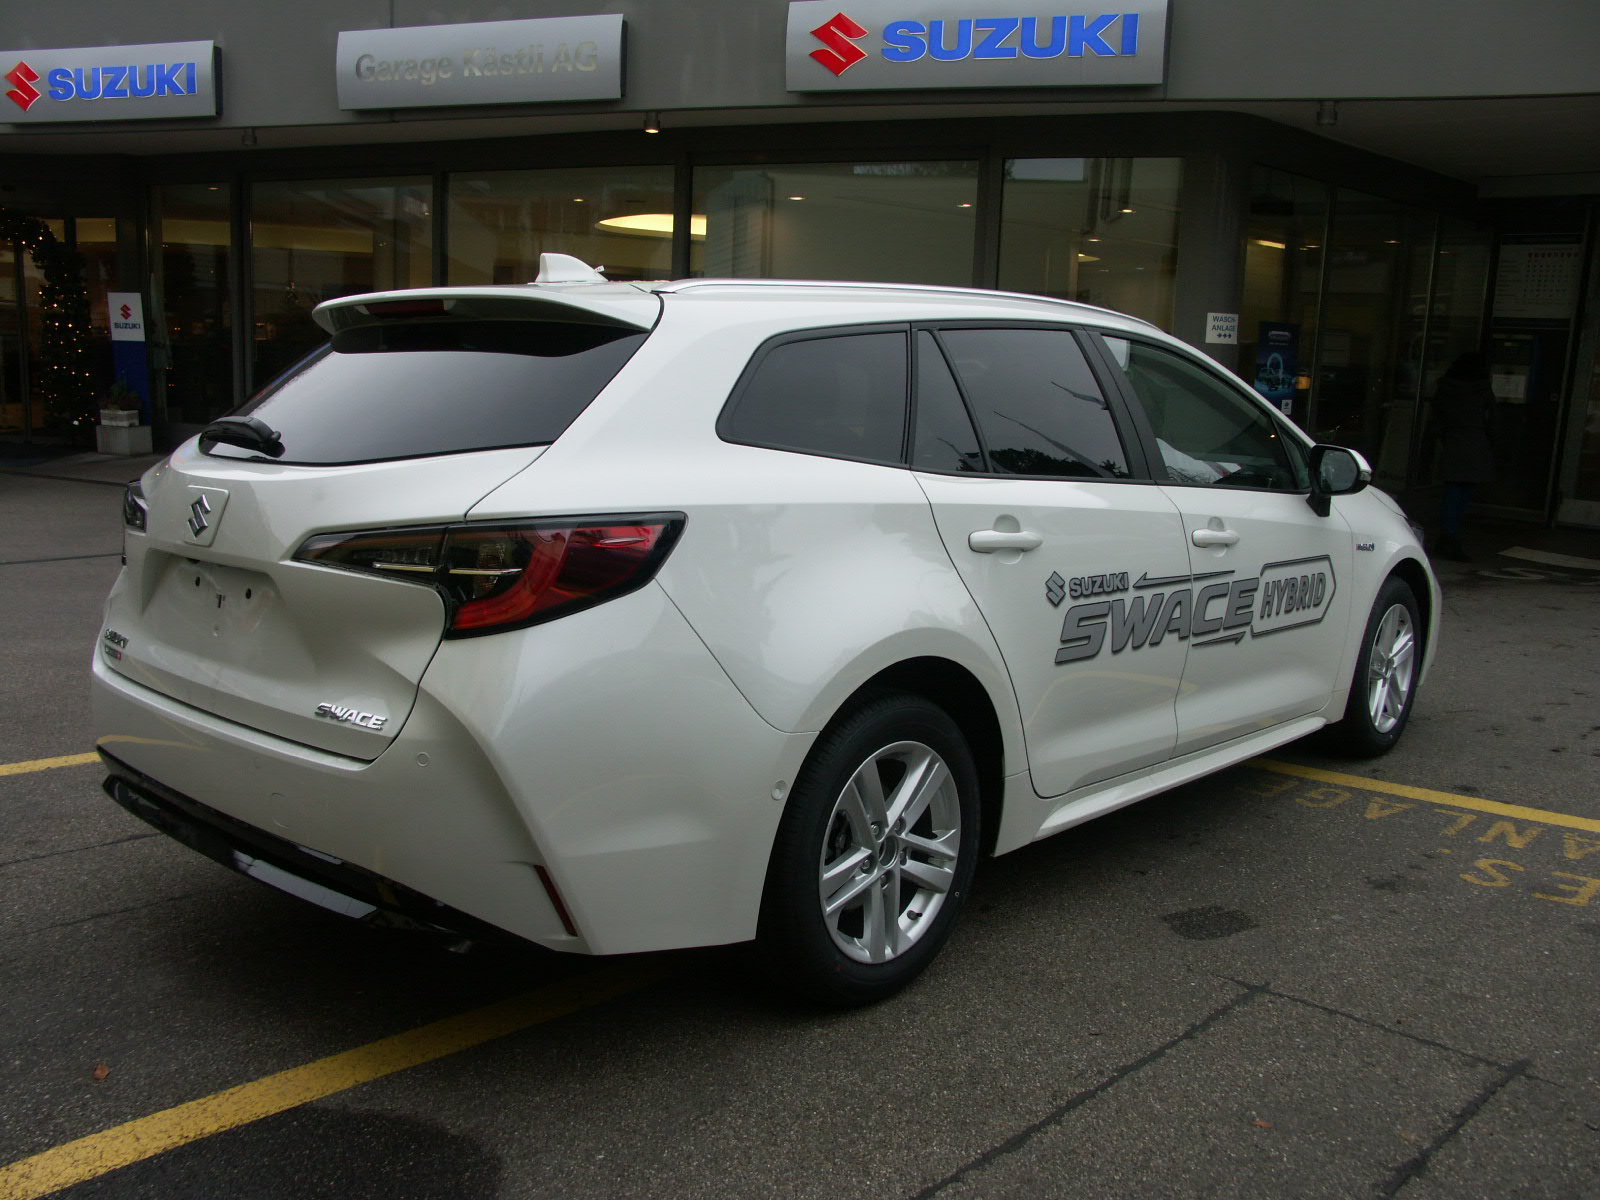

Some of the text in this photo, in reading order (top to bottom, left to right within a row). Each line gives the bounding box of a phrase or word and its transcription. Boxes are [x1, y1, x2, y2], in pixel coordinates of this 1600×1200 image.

[881, 13, 1139, 62] SUZUKI
[48, 62, 197, 101] SUZUKI
[355, 41, 599, 86] Garage Kästli AG
[114, 321, 141, 329] SUZUKI
[1069, 572, 1129, 599] SUZUKI
[1055, 572, 1326, 665] SWACE HYBRID
[315, 702, 387, 731] SWACE
